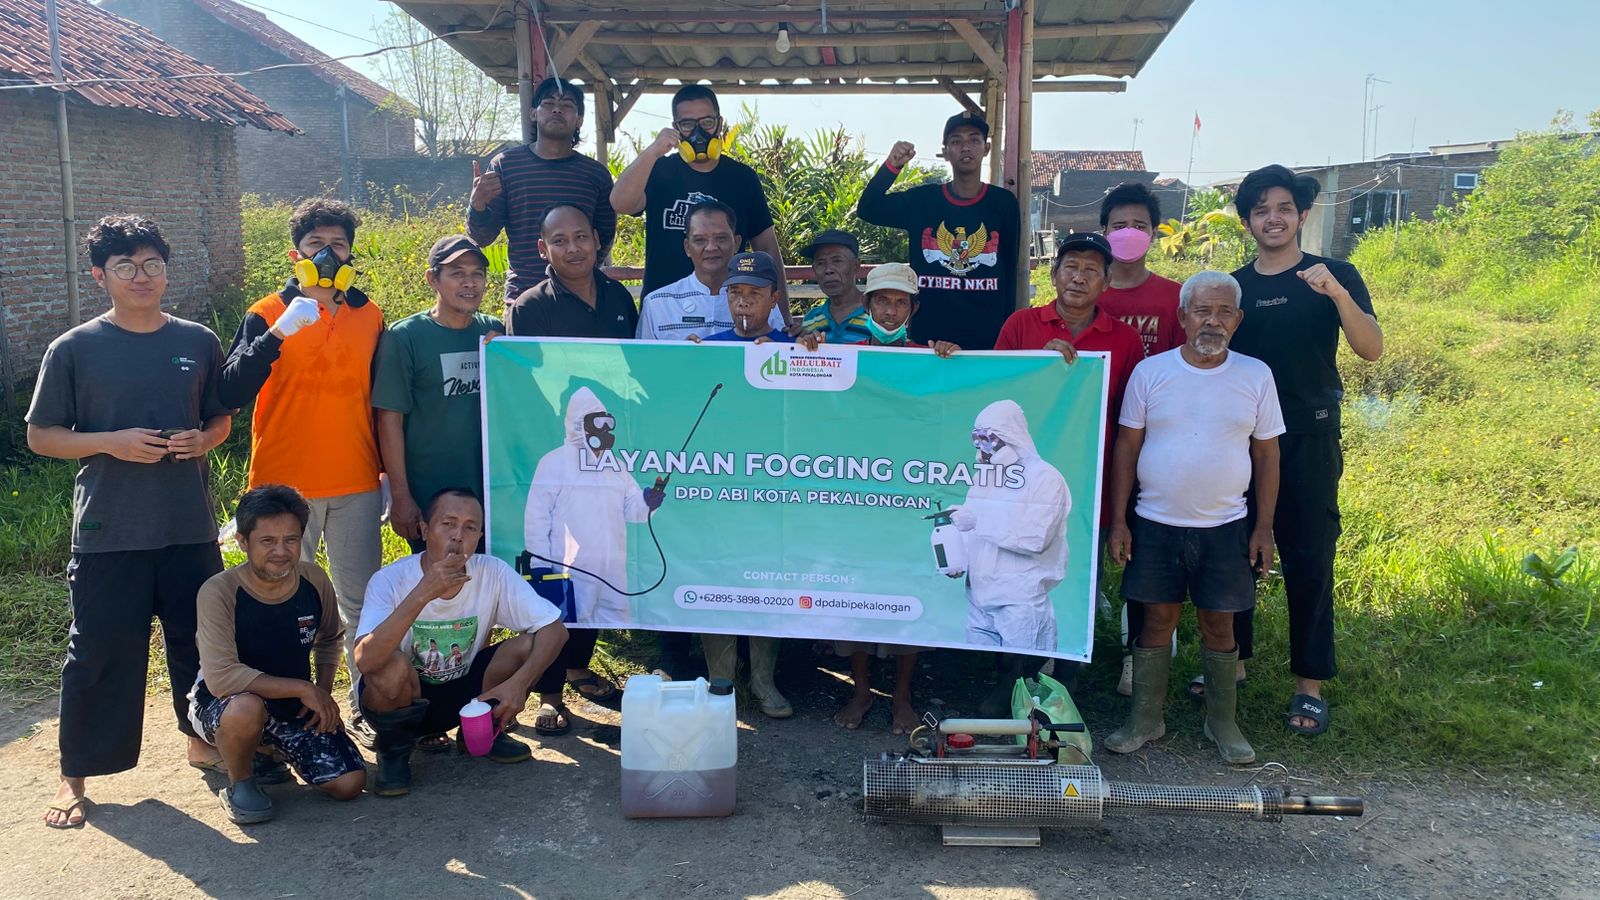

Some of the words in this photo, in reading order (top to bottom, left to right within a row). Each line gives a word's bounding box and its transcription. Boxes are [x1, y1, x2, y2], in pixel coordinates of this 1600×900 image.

[918, 275, 961, 290] CYBER
[964, 277, 999, 291] NKRI
[789, 359, 842, 368] AHLULBAIT
[578, 448, 736, 475] LAYANAN
[745, 452, 894, 482] FOGGING
[902, 459, 1026, 490] GRATIS
[675, 486, 714, 501] DPD
[717, 486, 749, 502] ABI
[753, 488, 802, 504] KOTA
[806, 490, 932, 510] PEKALONGAN
[743, 570, 798, 583] CONTACT
[801, 573, 849, 585] PERSON
[699, 593, 795, 607] +62895-3898-02020
[814, 598, 911, 613] dpdabipekalongan
